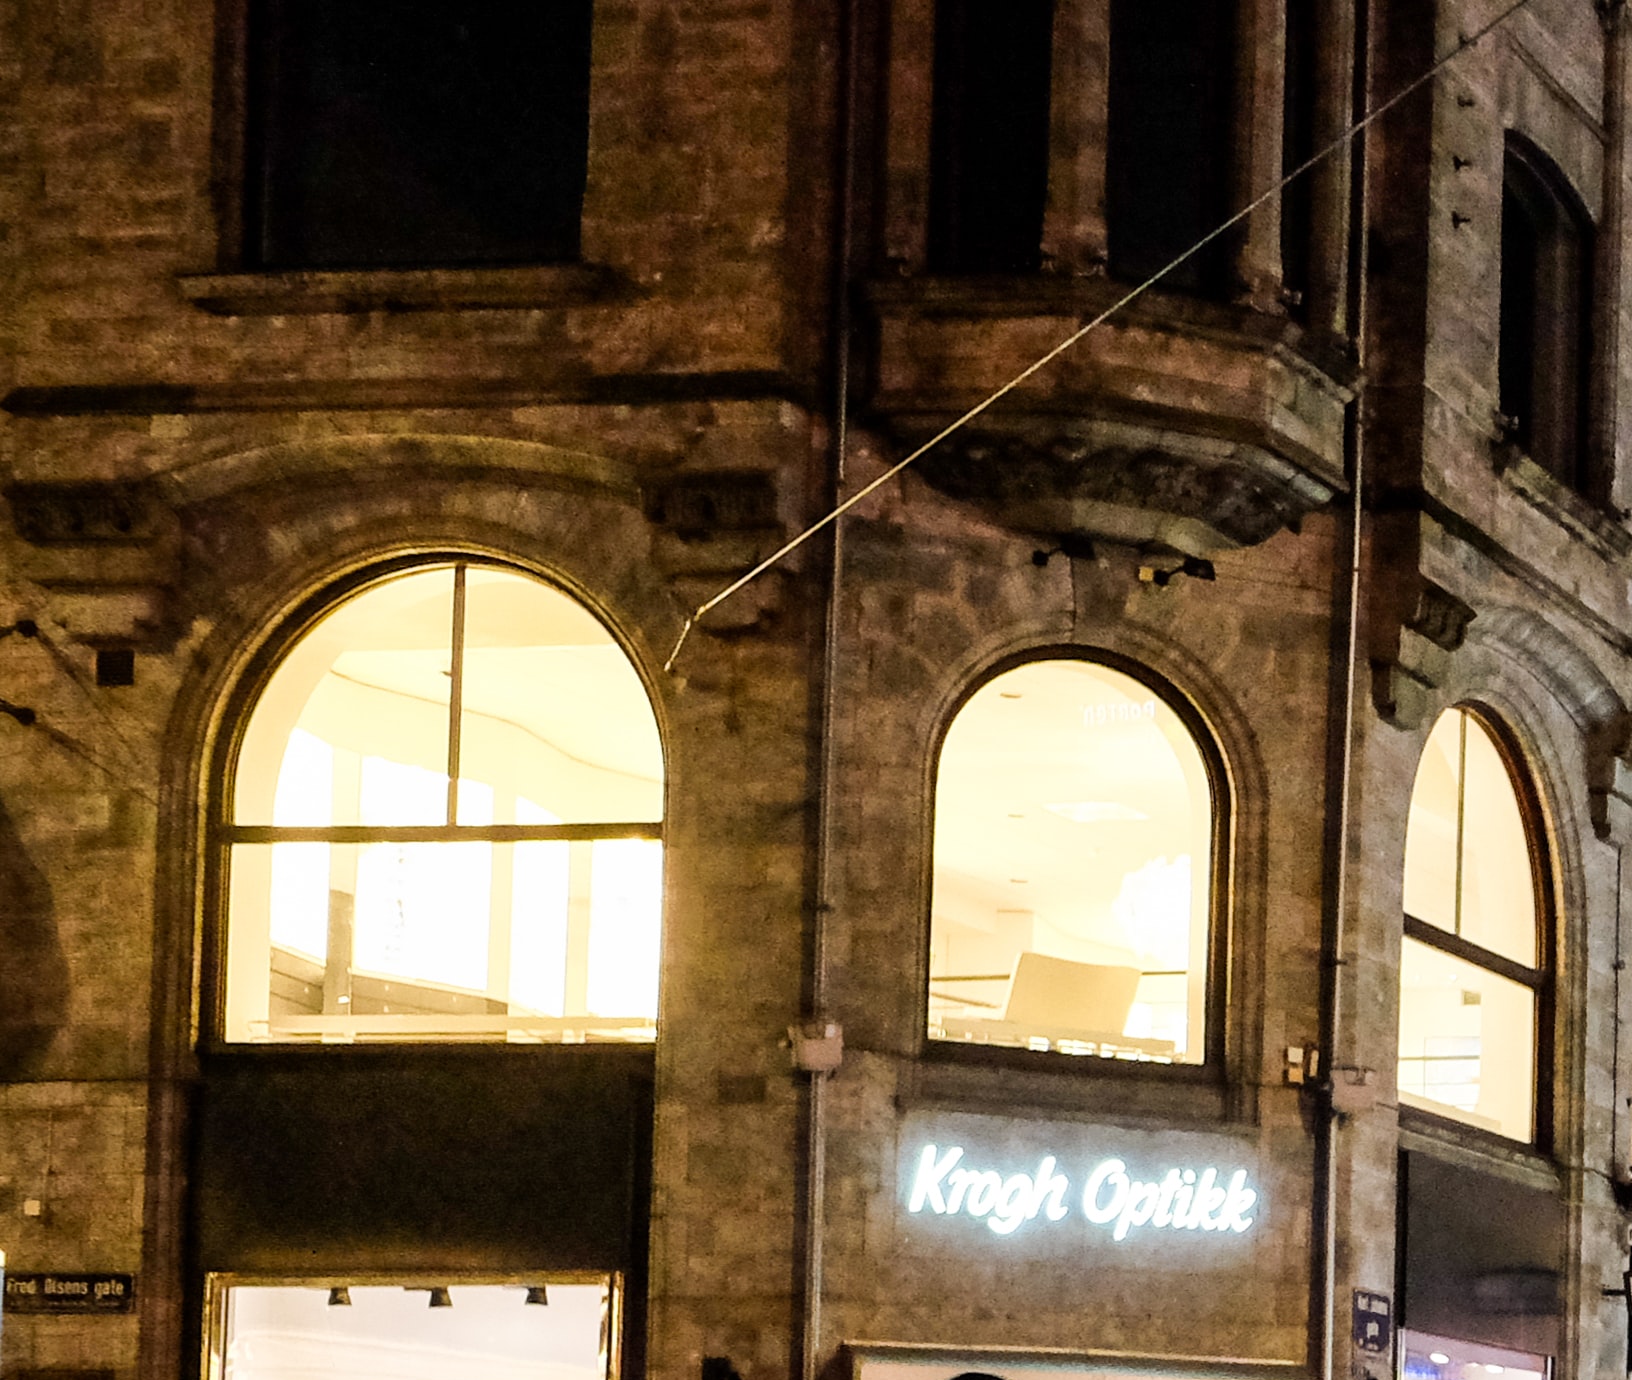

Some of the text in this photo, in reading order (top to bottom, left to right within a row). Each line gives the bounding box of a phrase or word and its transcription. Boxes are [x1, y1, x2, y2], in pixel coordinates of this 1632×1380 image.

[908, 1144, 1257, 1242] Krogh Optikk
[6, 1278, 124, 1299] Fred Olsens gate
